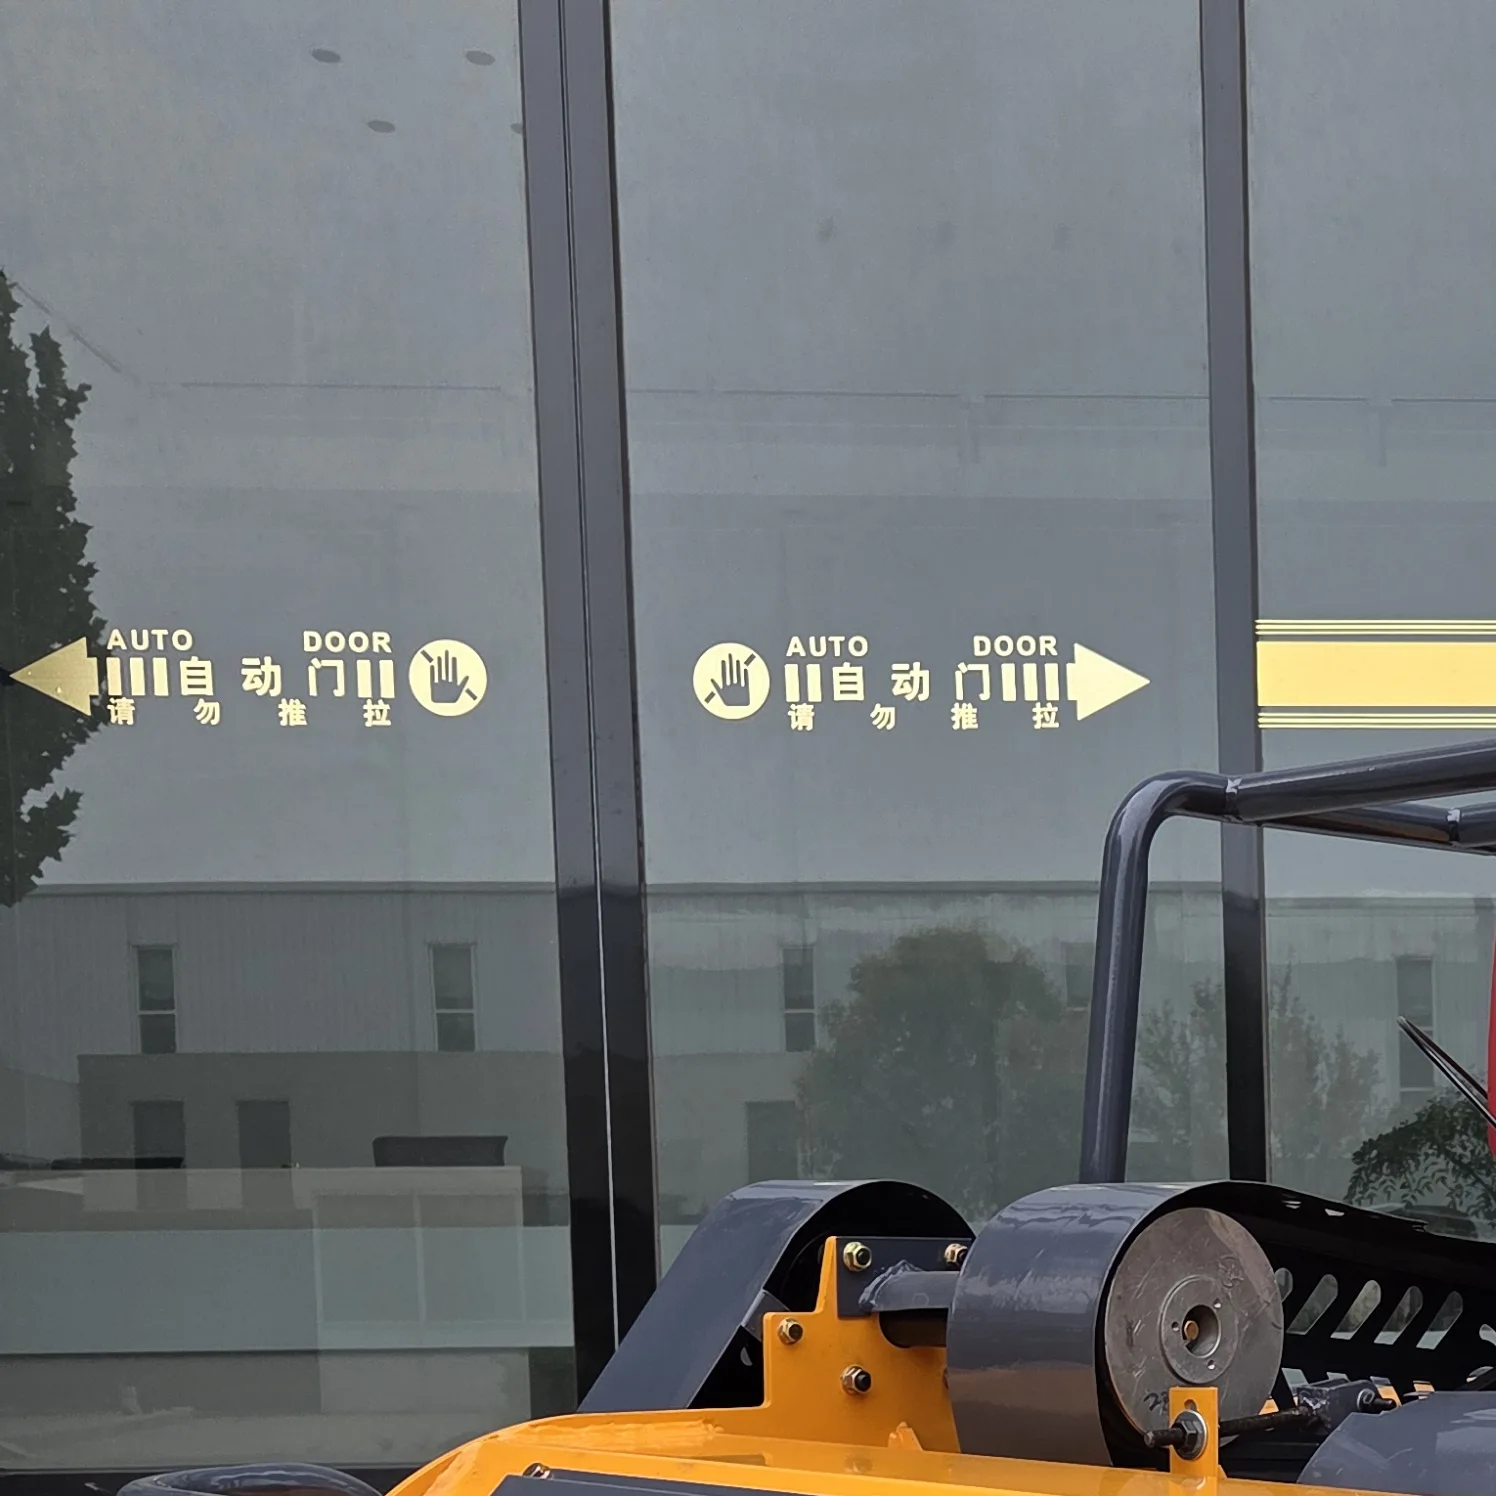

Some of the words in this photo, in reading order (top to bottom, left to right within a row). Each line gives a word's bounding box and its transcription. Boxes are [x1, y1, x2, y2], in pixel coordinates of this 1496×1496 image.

[107, 629, 193, 651] AUTO
[303, 631, 392, 653] DOOR
[786, 636, 868, 657] AUTO
[973, 635, 1058, 656] DOOR
[180, 657, 345, 698] 自动门
[832, 662, 990, 701] 自动门
[107, 697, 392, 727] 请勿推拉
[788, 702, 1059, 731] 请勿推拉
